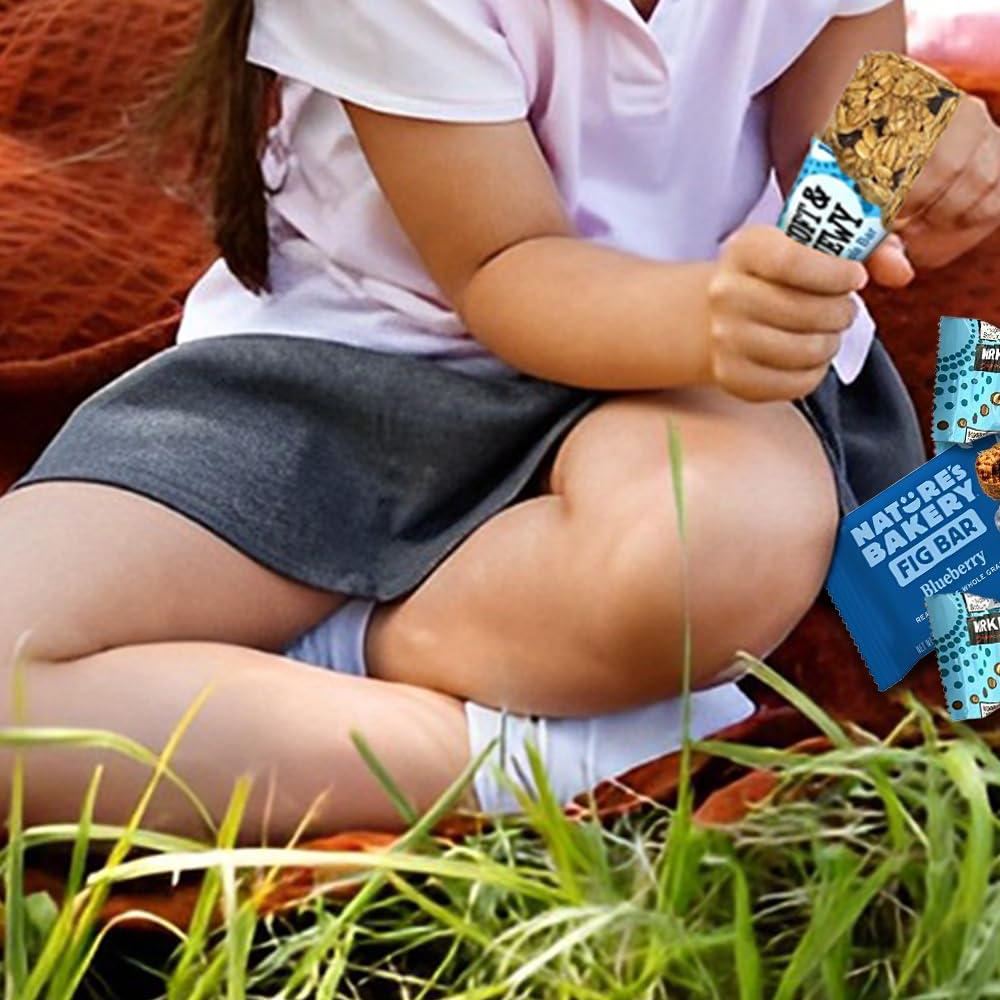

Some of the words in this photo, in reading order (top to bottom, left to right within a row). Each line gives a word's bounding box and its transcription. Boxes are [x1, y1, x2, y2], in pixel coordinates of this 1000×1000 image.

[802, 185, 832, 209] &
[785, 202, 822, 244] OFT
[812, 202, 864, 256] EWY
[861, 478, 977, 568] BAKERY
[896, 546, 934, 579] FIG
[933, 517, 978, 555] BAR
[920, 551, 987, 597] Blueberry
[962, 573, 986, 593] WHOLE
